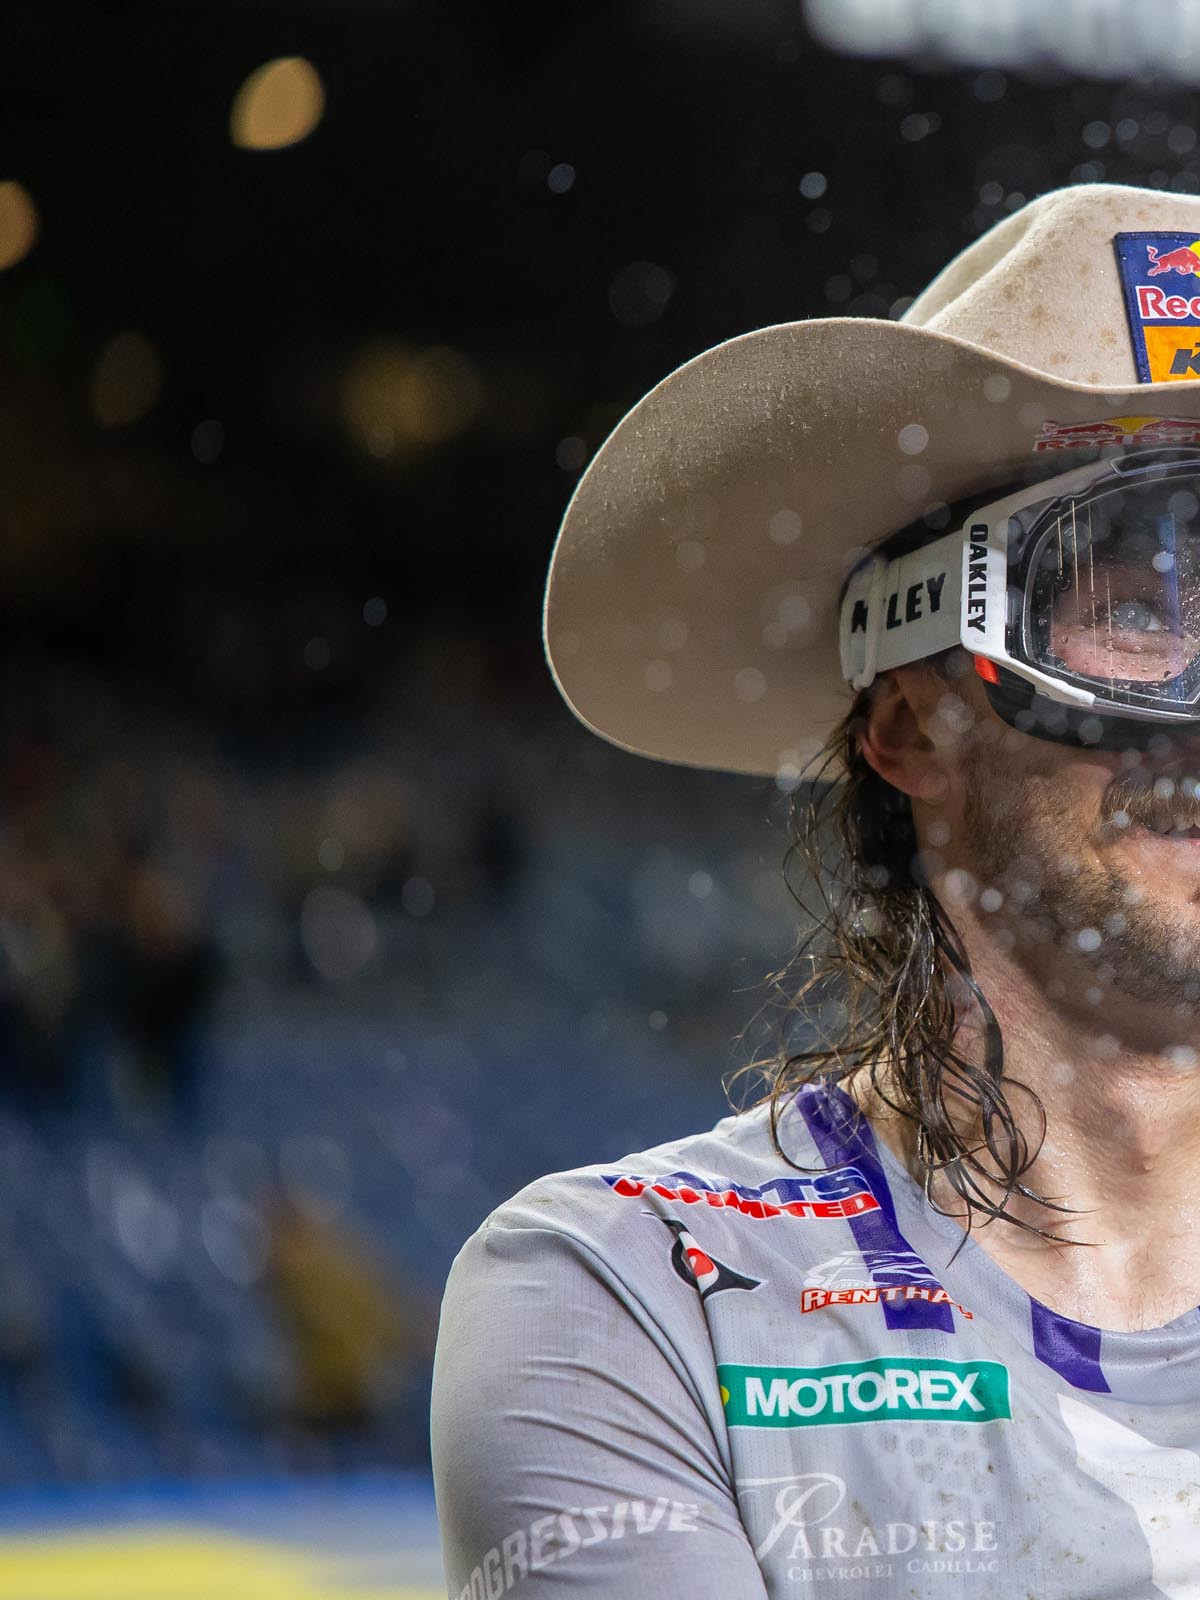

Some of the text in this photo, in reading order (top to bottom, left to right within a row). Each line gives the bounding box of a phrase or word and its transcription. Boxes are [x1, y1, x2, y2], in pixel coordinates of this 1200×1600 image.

[967, 523, 988, 634] OAKLEY
[745, 1369, 985, 1418] MOTOREX
[454, 1497, 699, 1600] OGRESSIVE
[736, 1472, 999, 1562] PARADISE
[788, 1558, 999, 1582] CHEVROLET CADILLAC
